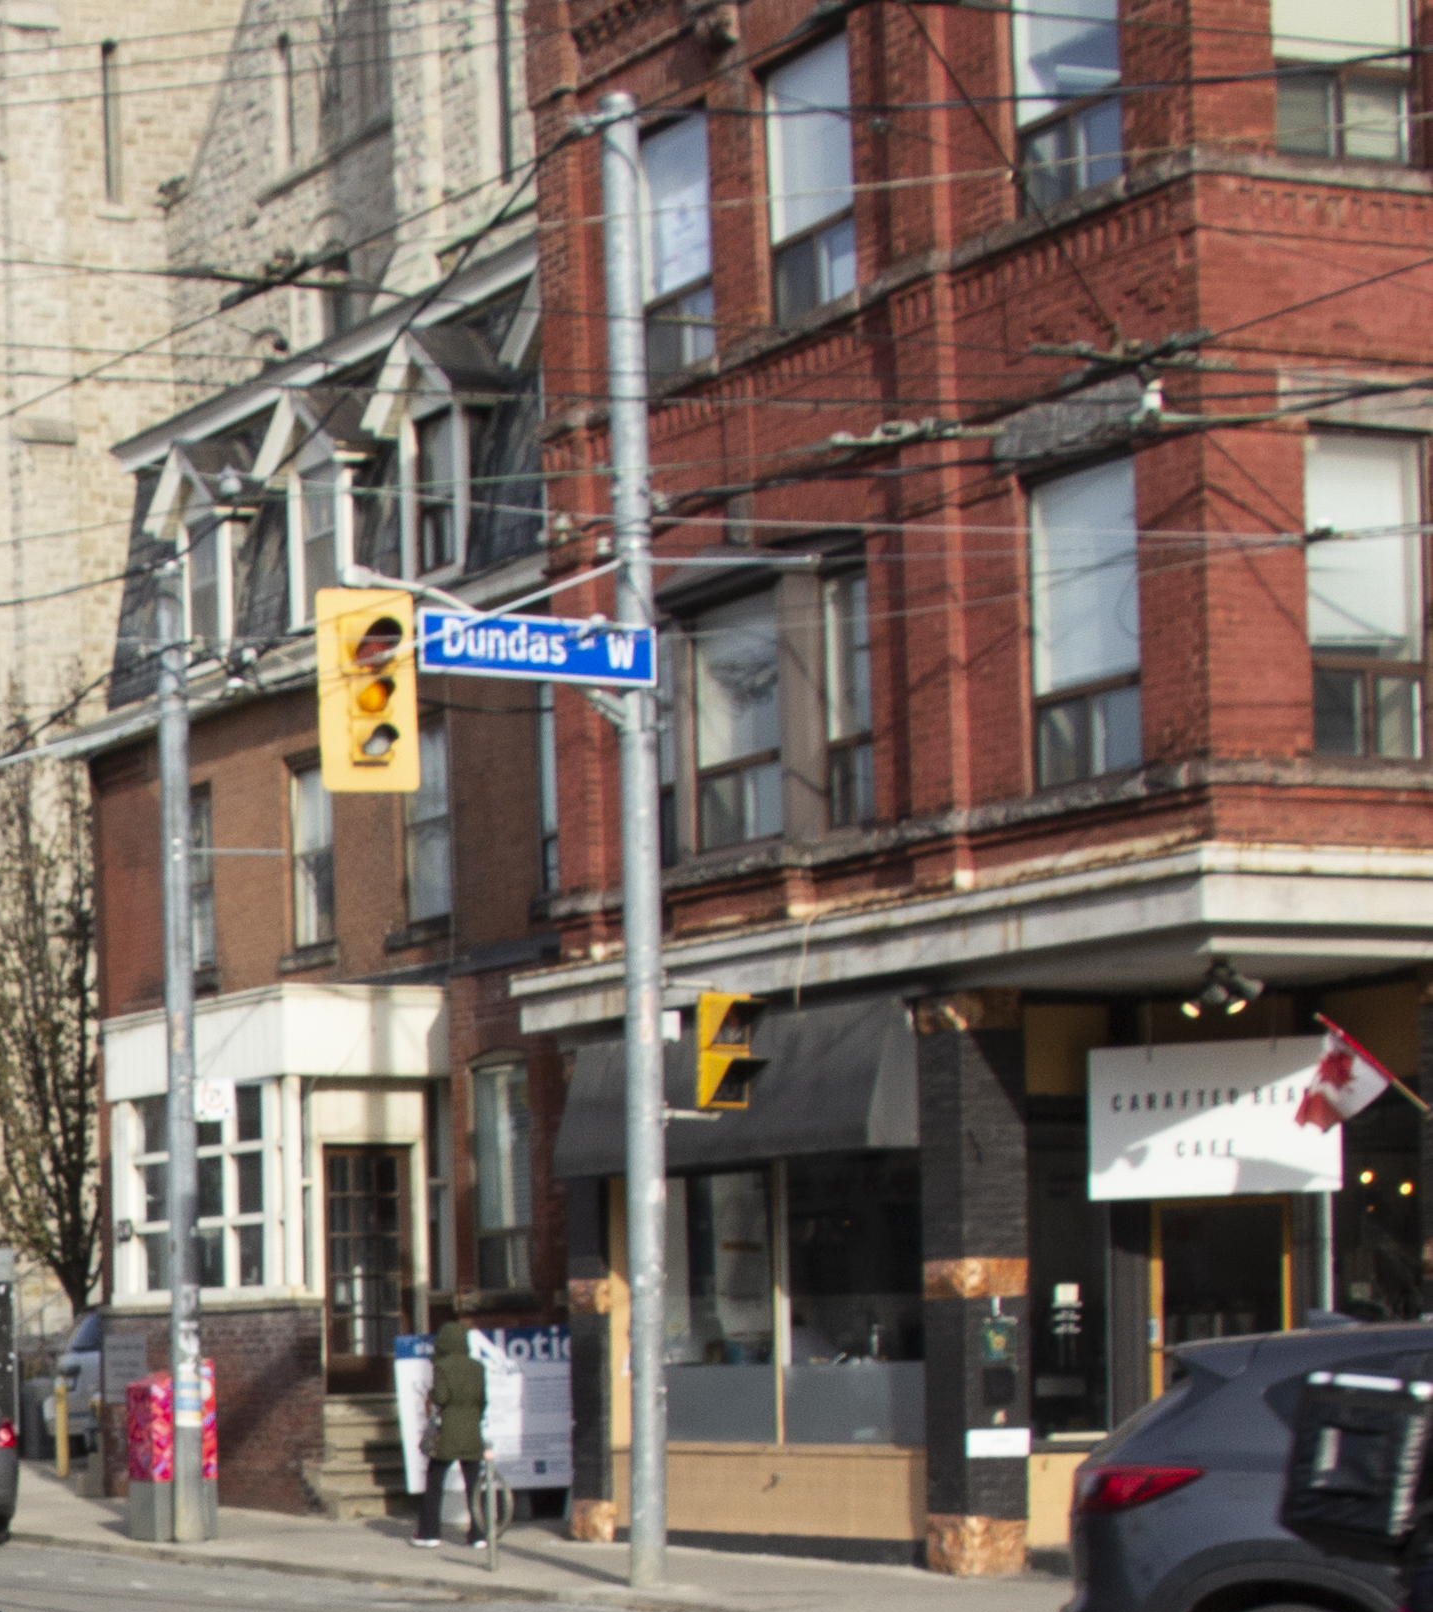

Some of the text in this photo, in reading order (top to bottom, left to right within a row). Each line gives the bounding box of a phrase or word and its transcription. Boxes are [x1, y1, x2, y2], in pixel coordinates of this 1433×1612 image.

[442, 617, 635, 670] Dundas W
[1111, 1084, 1309, 1113] CARAFTED BEA
[1177, 1139, 1235, 1157] CAFE
